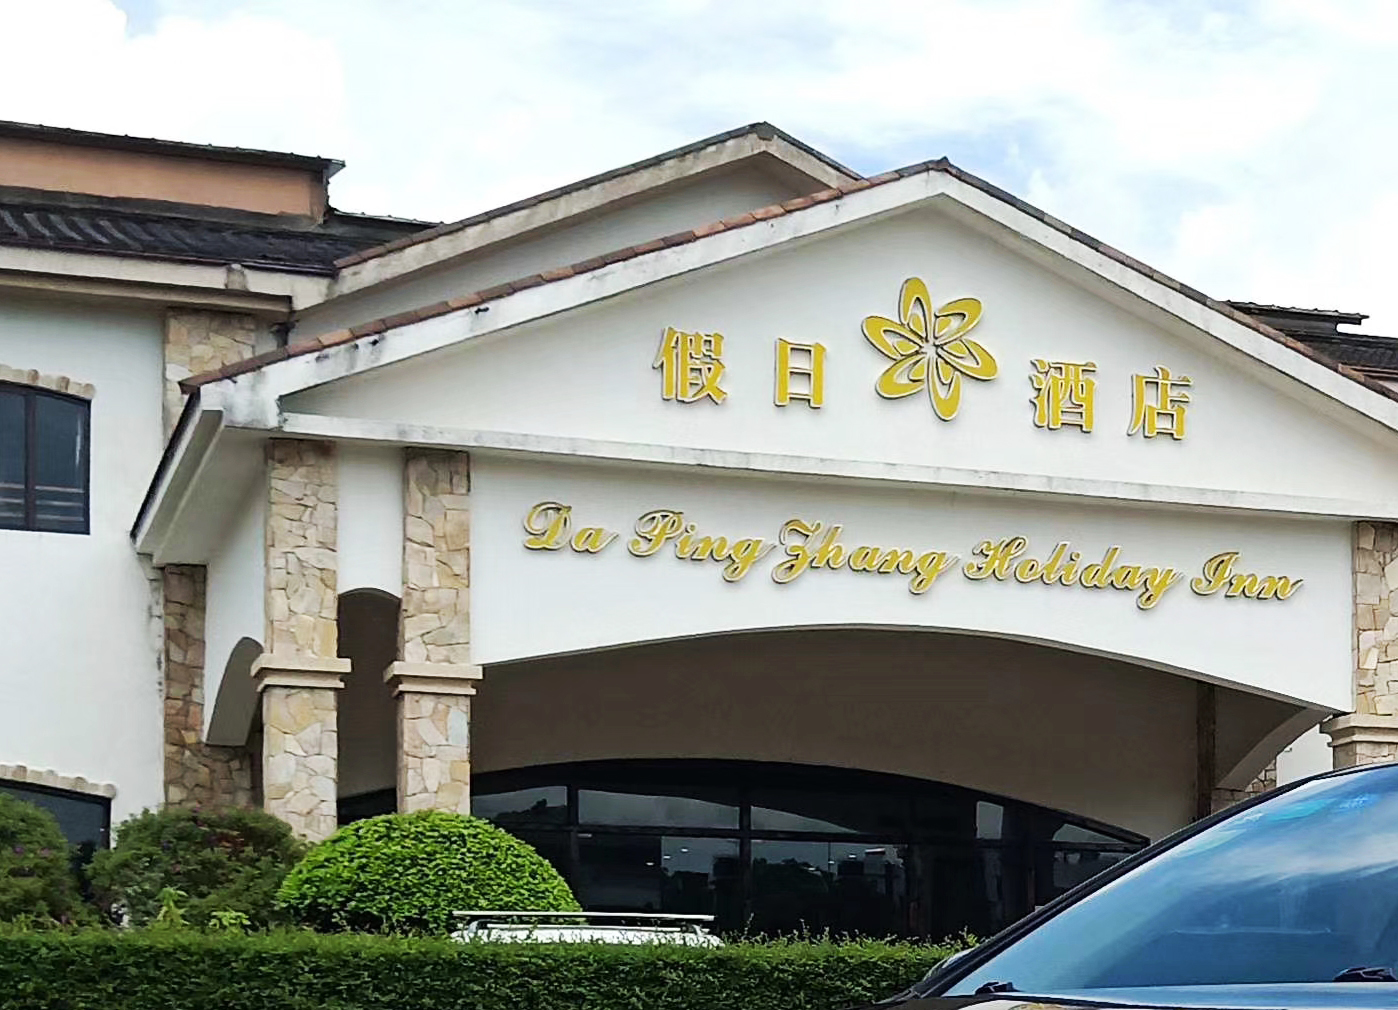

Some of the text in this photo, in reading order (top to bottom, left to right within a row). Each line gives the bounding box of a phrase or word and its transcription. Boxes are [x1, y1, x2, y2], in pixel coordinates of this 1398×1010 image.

[652, 326, 1192, 440] 假日 酒店
[523, 501, 1304, 609] Da Ping Zhang Holiday Inn
